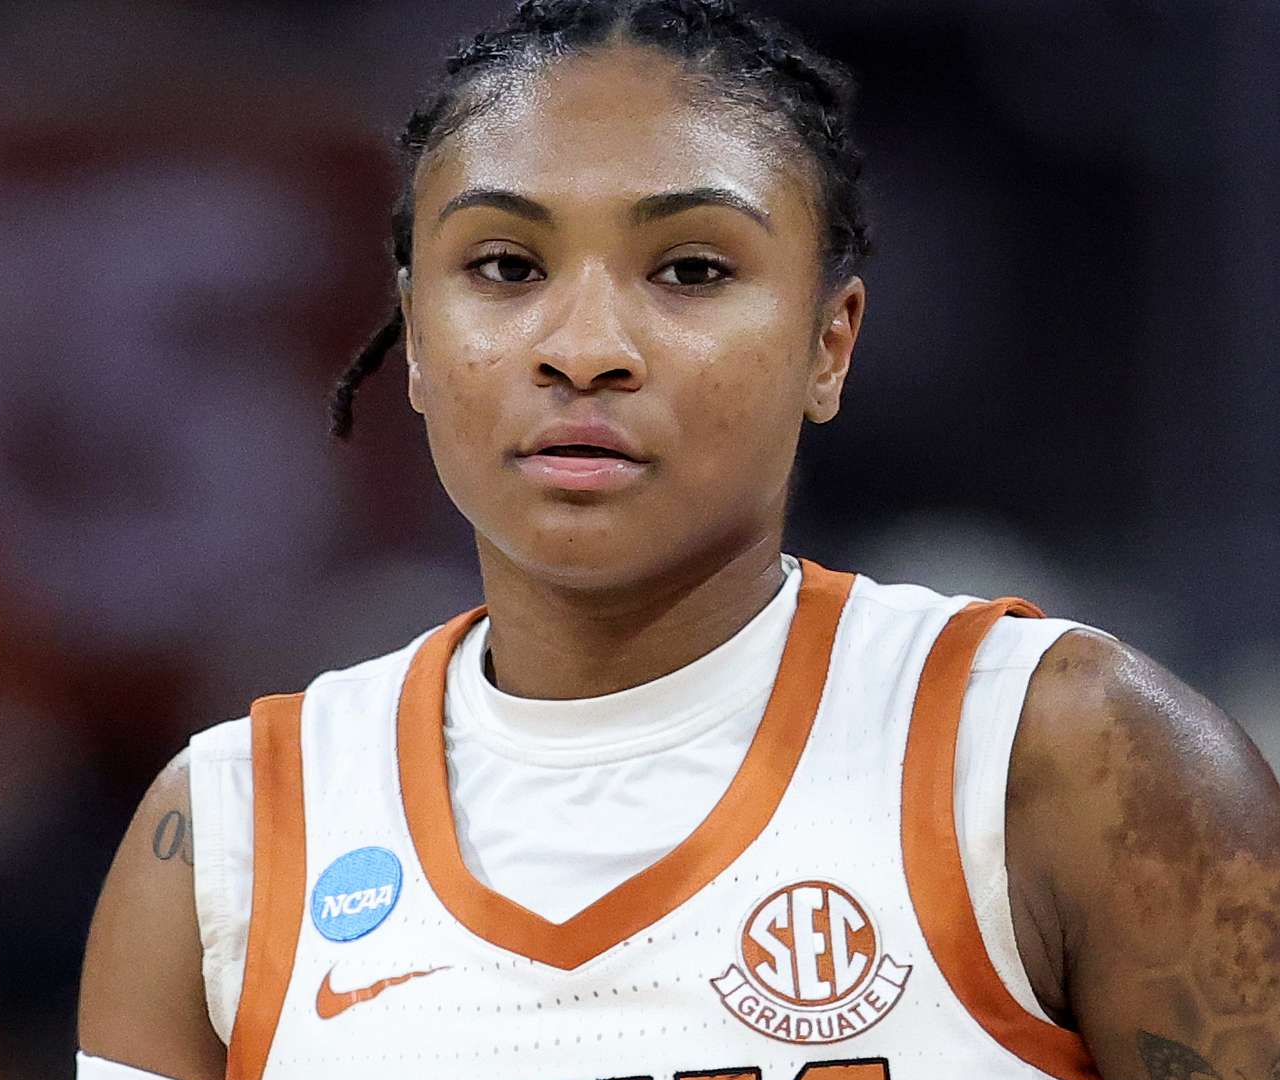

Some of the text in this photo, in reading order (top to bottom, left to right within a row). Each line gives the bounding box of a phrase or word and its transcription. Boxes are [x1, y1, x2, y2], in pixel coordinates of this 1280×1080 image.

[322, 884, 394, 919] NCAA
[748, 886, 869, 1001] SEC
[737, 989, 888, 1040] GRADUATE
